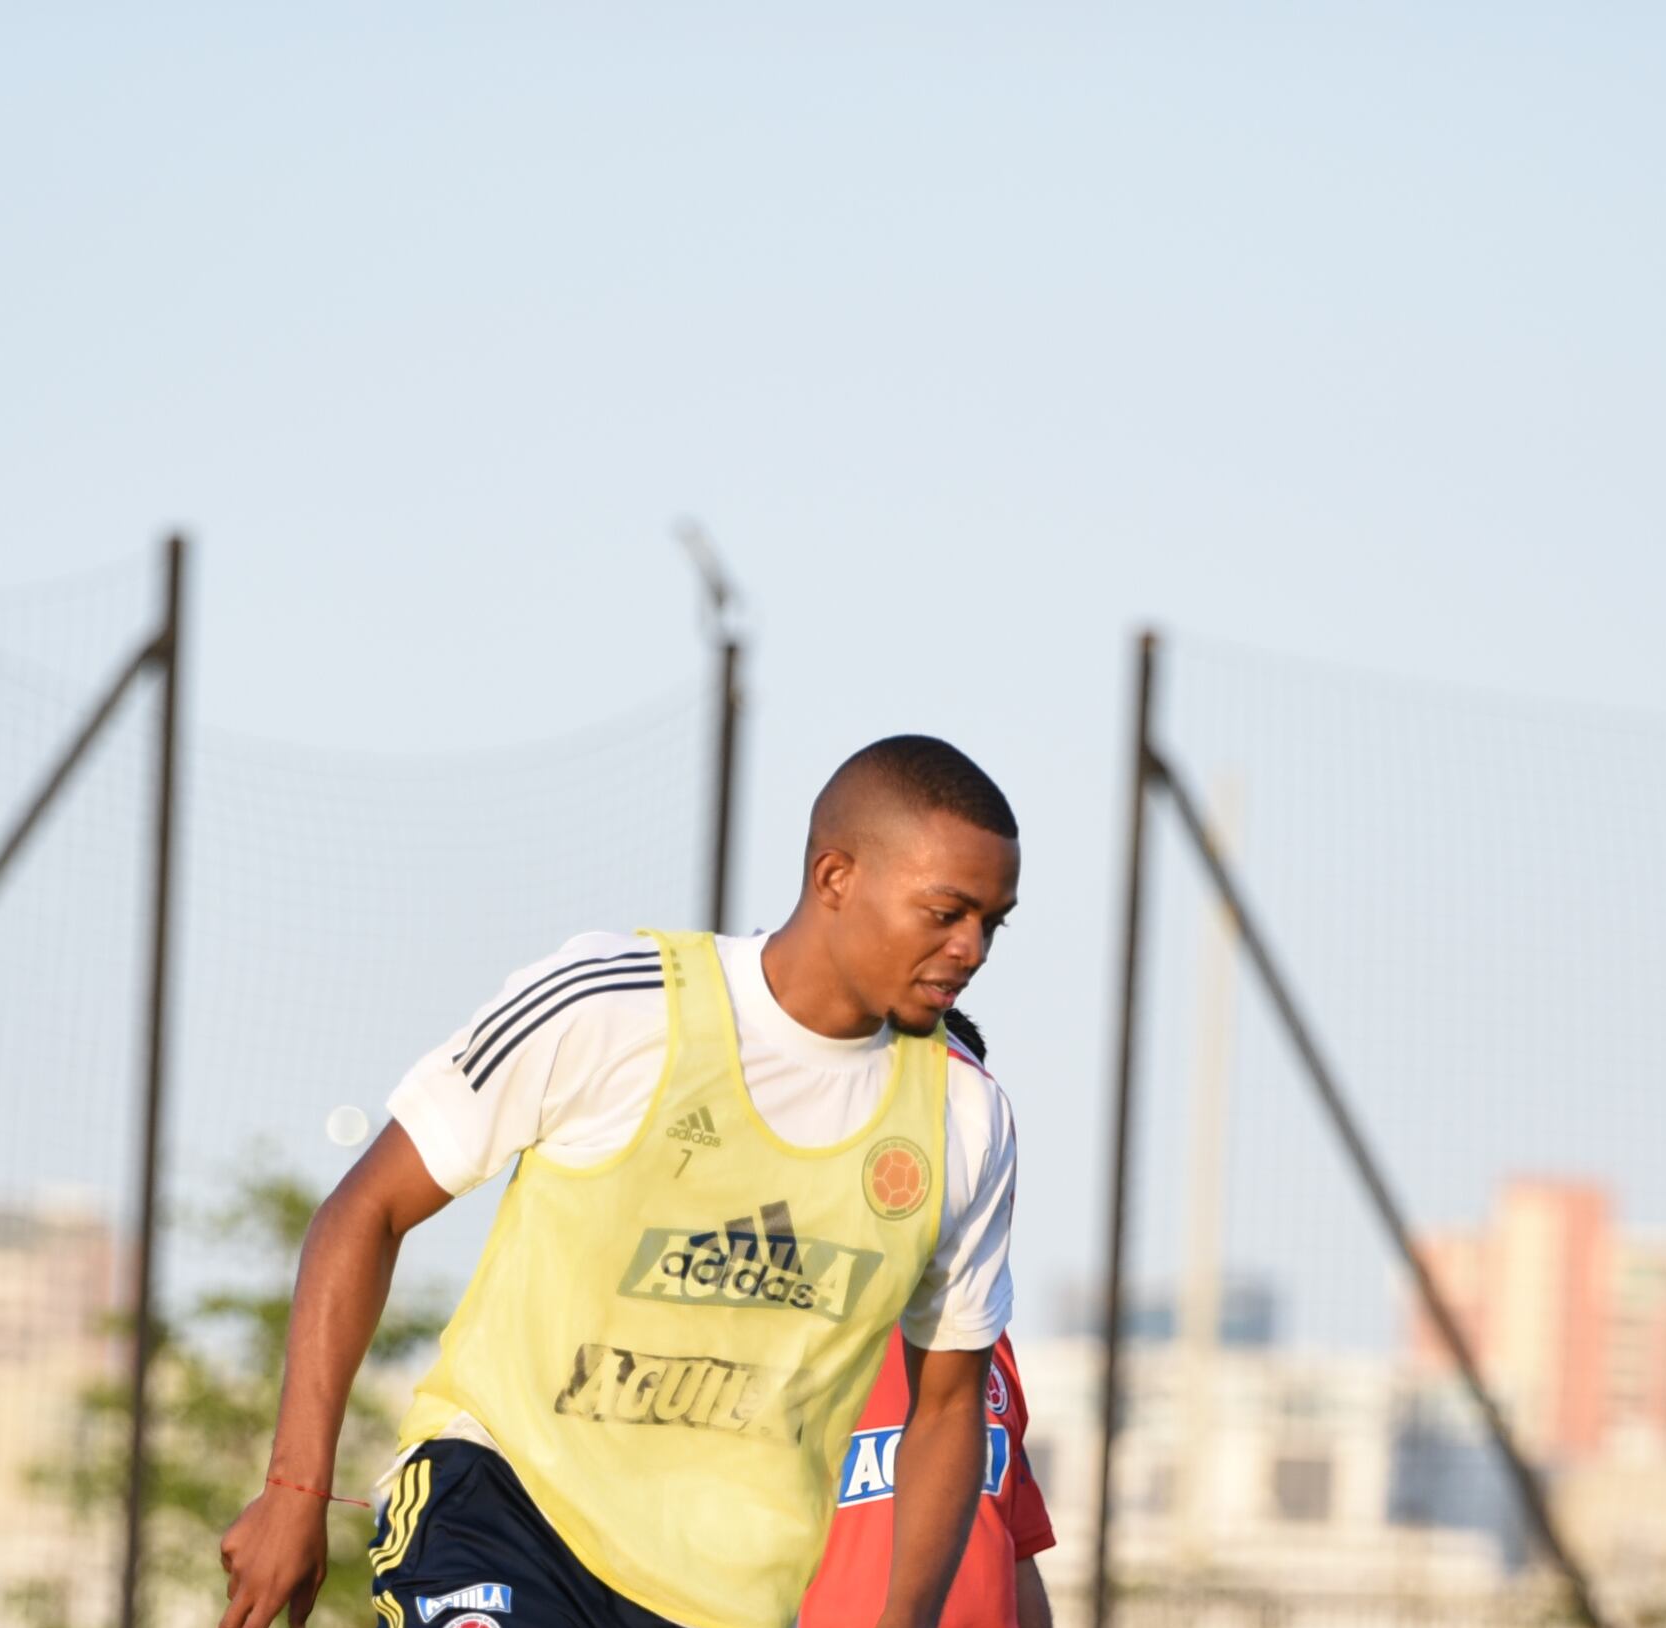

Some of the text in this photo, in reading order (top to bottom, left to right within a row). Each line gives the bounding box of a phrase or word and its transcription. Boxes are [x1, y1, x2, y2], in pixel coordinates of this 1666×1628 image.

[665, 1126, 723, 1148] adidas
[674, 1148, 693, 1179] 7
[660, 1251, 816, 1311] adidas
